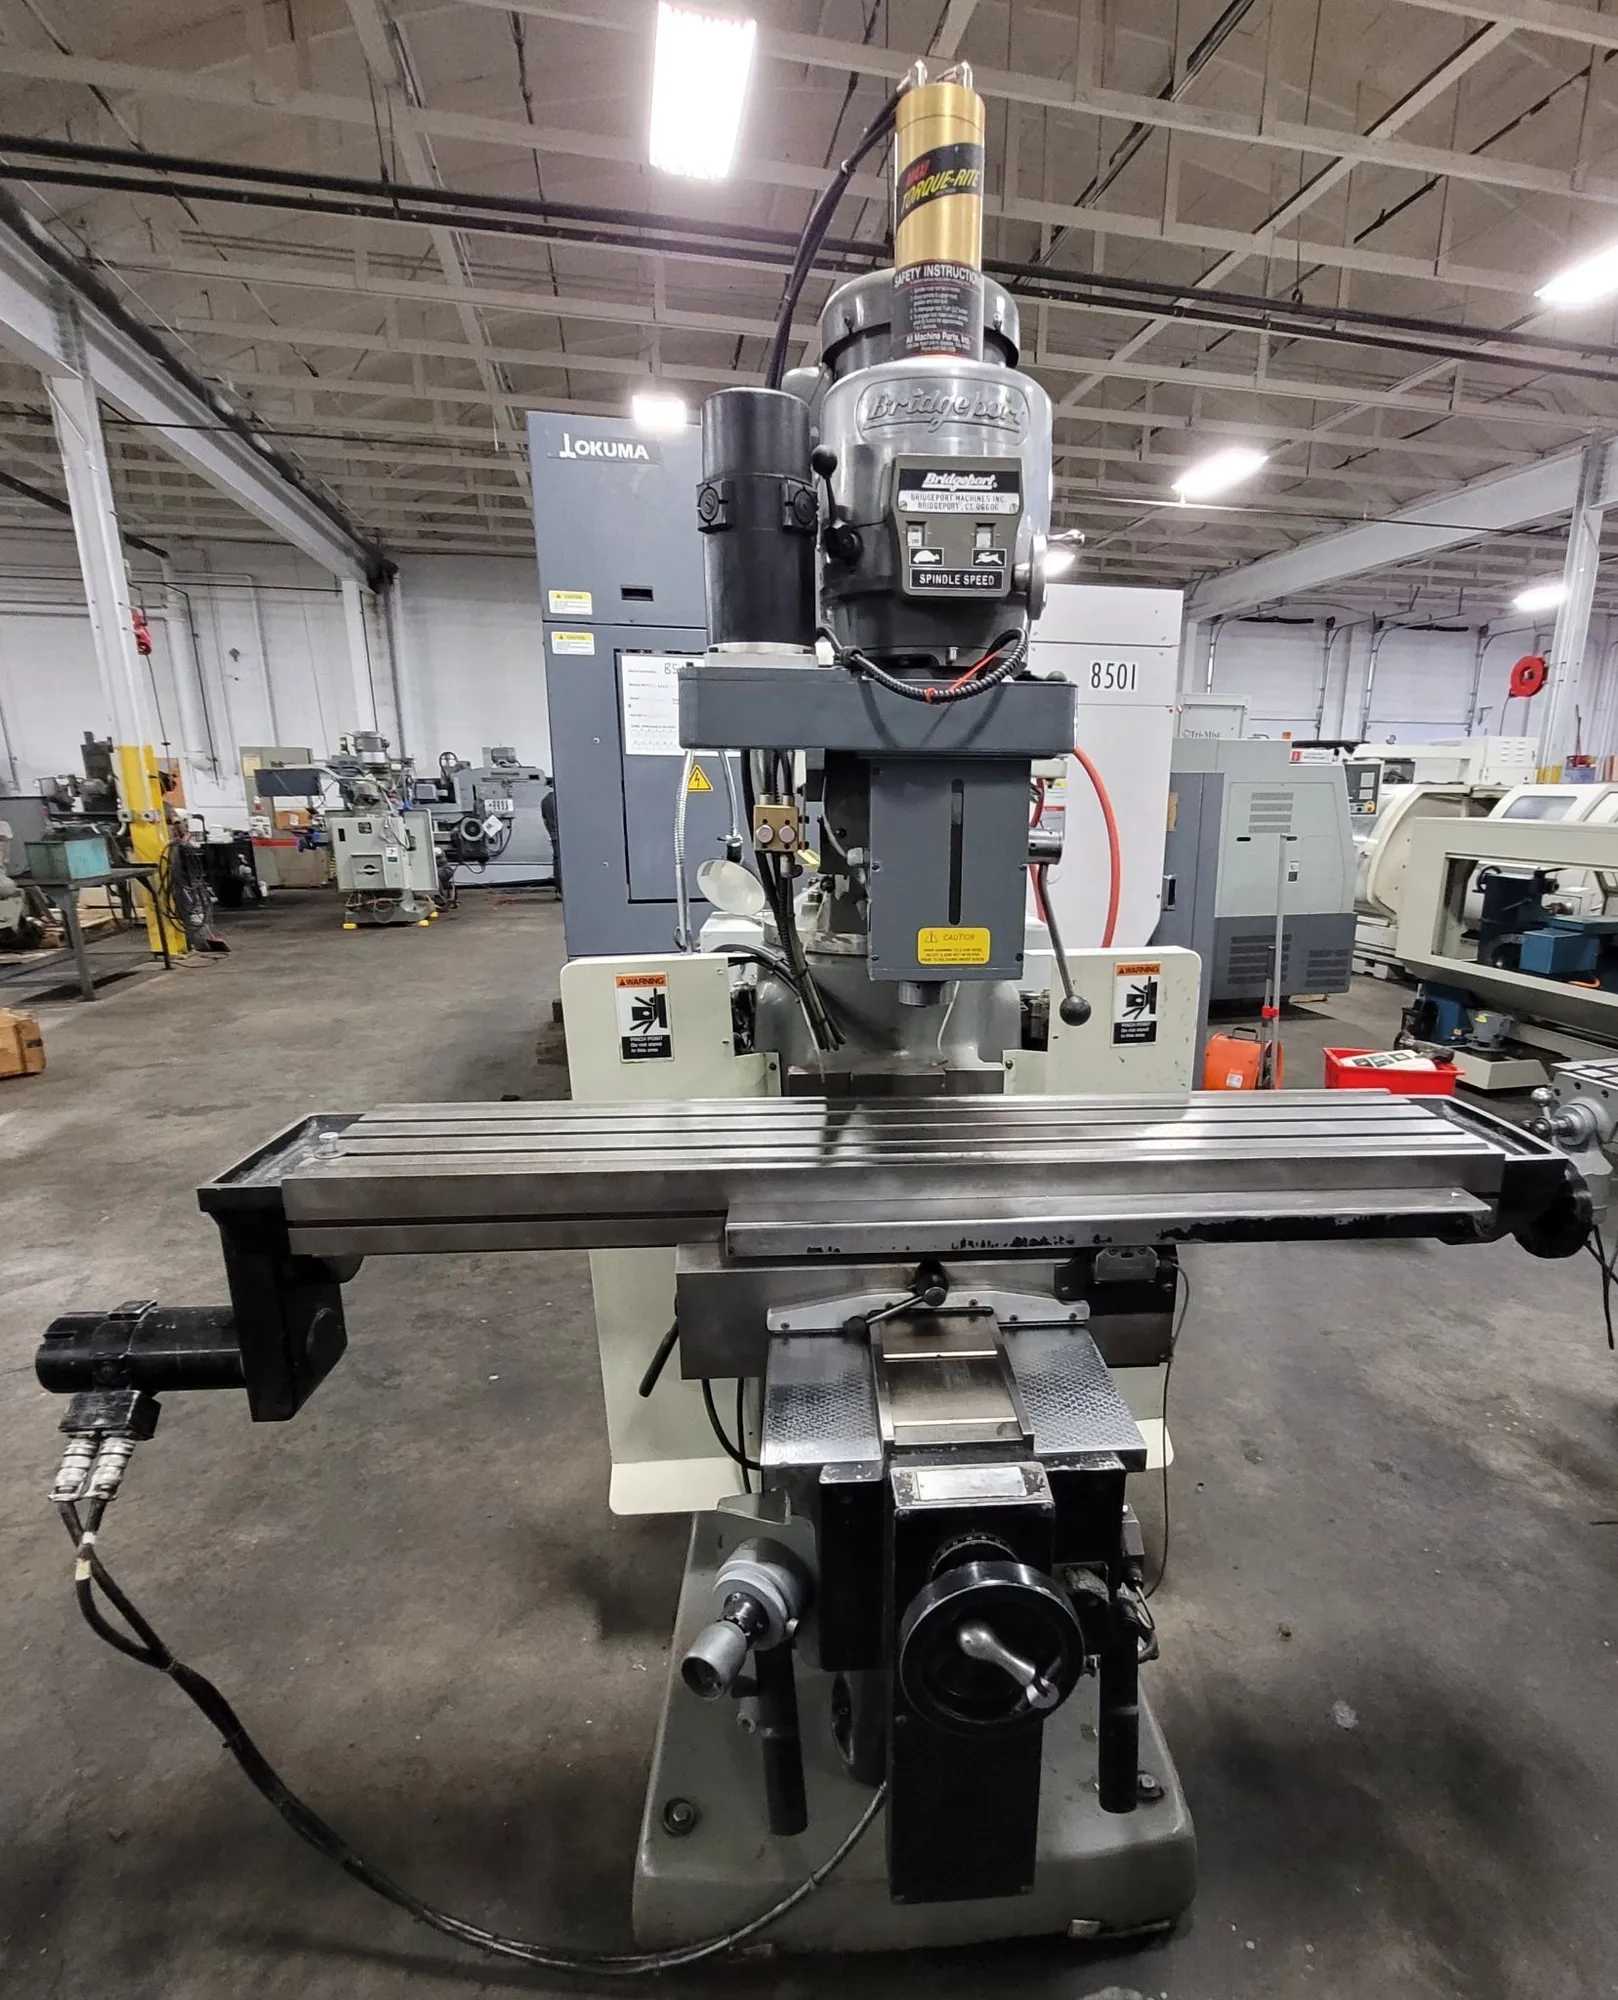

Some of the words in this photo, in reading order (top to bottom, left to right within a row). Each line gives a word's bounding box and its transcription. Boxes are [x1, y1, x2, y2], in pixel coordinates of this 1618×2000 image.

[894, 266, 921, 288] SAFETY
[923, 264, 977, 284] INSTRUCTIO
[867, 387, 1024, 433] Bridgeport
[922, 472, 995, 491] Bridgeport
[919, 574, 960, 585] SPINDLE
[963, 575, 995, 586] SPEED
[1091, 662, 1136, 690] 8501
[1125, 966, 1160, 974] WARNING
[626, 976, 664, 986] WARNING
